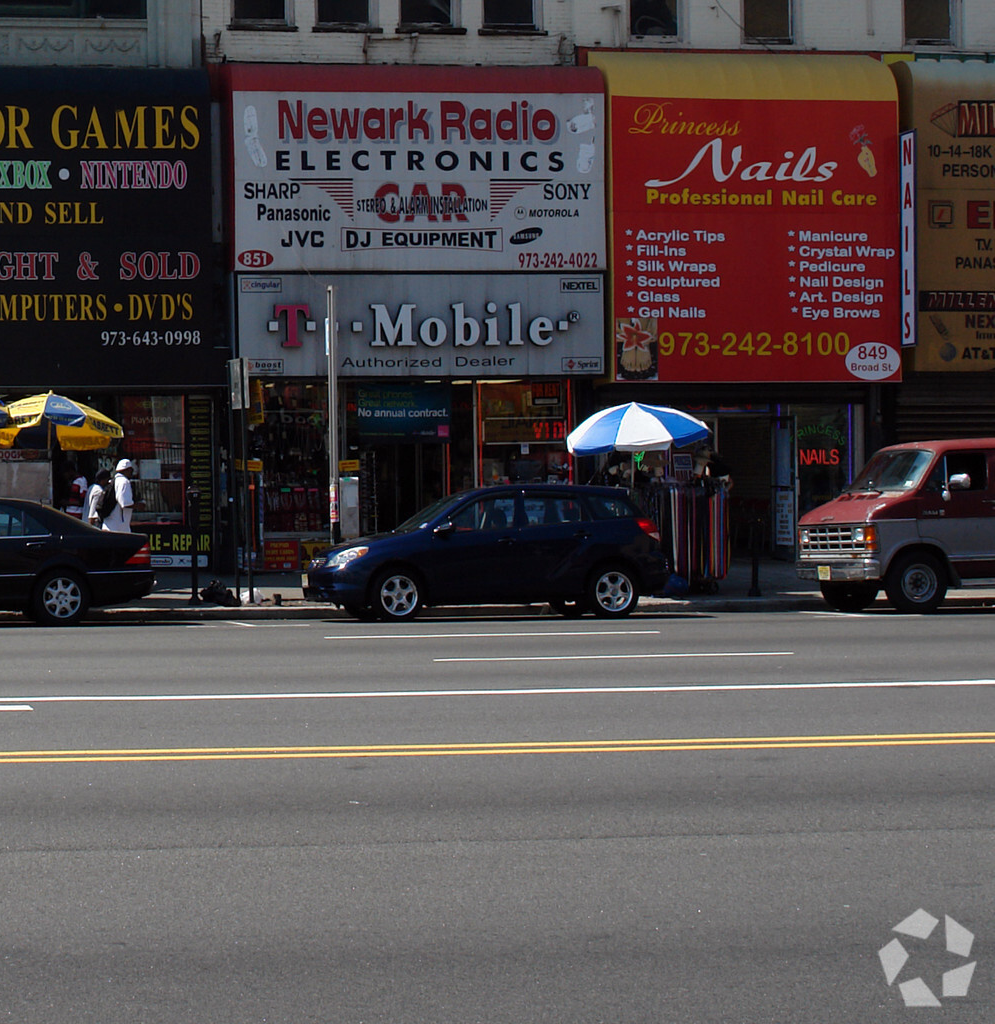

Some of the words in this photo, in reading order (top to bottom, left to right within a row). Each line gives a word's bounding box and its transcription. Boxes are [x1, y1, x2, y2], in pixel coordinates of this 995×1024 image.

[278, 100, 431, 142] Newark
[440, 100, 558, 143] Radio
[628, 102, 742, 136] Princess
[51, 104, 201, 150] GAMES
[927, 145, 992, 158] 10-14-18K
[275, 150, 565, 172] ELECTRONICS
[644, 138, 838, 188] Nails
[80, 160, 187, 189] NINTENDO
[244, 182, 300, 199] SHARP
[543, 183, 591, 200] SONY
[646, 188, 772, 206] Professional
[782, 189, 824, 206] Nail
[831, 189, 877, 206] Care
[356, 199, 387, 214] STEREO
[399, 199, 429, 215] ALARM
[431, 199, 488, 215] INSTALLATION
[373, 182, 470, 223] CAR
[44, 202, 104, 224] SELL
[257, 204, 331, 222] Panasonic
[528, 208, 579, 218] MOTOROLA
[281, 230, 325, 248] JVC
[346, 230, 371, 248] DJ
[382, 230, 497, 248] EQUIPMENT
[636, 230, 690, 243] Acrylic
[693, 230, 725, 243] Tips
[799, 230, 868, 242] Manicure
[903, 137, 912, 339] NAILS
[637, 245, 686, 257] Fill-Ins
[799, 246, 852, 259] Crystal
[856, 246, 895, 260] Wrap
[77, 252, 100, 280] &
[119, 252, 201, 280] SOLD
[243, 252, 268, 266] 851
[518, 253, 598, 268] 973-242-4022
[637, 260, 666, 272] Silk
[669, 261, 716, 274] Wraps
[800, 261, 866, 273] Pedicure
[251, 281, 280, 290] cingular
[562, 281, 598, 290] NEXTEL
[637, 276, 720, 290] Sculptured
[800, 276, 829, 288] Nail
[833, 276, 884, 290] Design
[638, 291, 680, 303] Glass
[799, 291, 827, 304] Art.
[832, 292, 883, 306] Design
[128, 293, 194, 321] DVD'S
[638, 306, 664, 319] Gel
[668, 307, 706, 319] Nails
[802, 307, 829, 321] Eye
[833, 307, 880, 319] Brows
[370, 303, 555, 347] Mobile
[101, 330, 201, 346] 973-643-0998
[659, 332, 850, 356] 973-242-8100
[857, 346, 888, 360] 849
[255, 361, 282, 369] boost
[341, 356, 442, 368] Authorized
[455, 355, 516, 368] Dealer
[851, 362, 879, 372] Broad
[881, 363, 893, 372] St.
[358, 407, 372, 417] No
[374, 408, 406, 417] annual
[408, 408, 449, 417] contract.
[799, 448, 840, 465] NAILS
